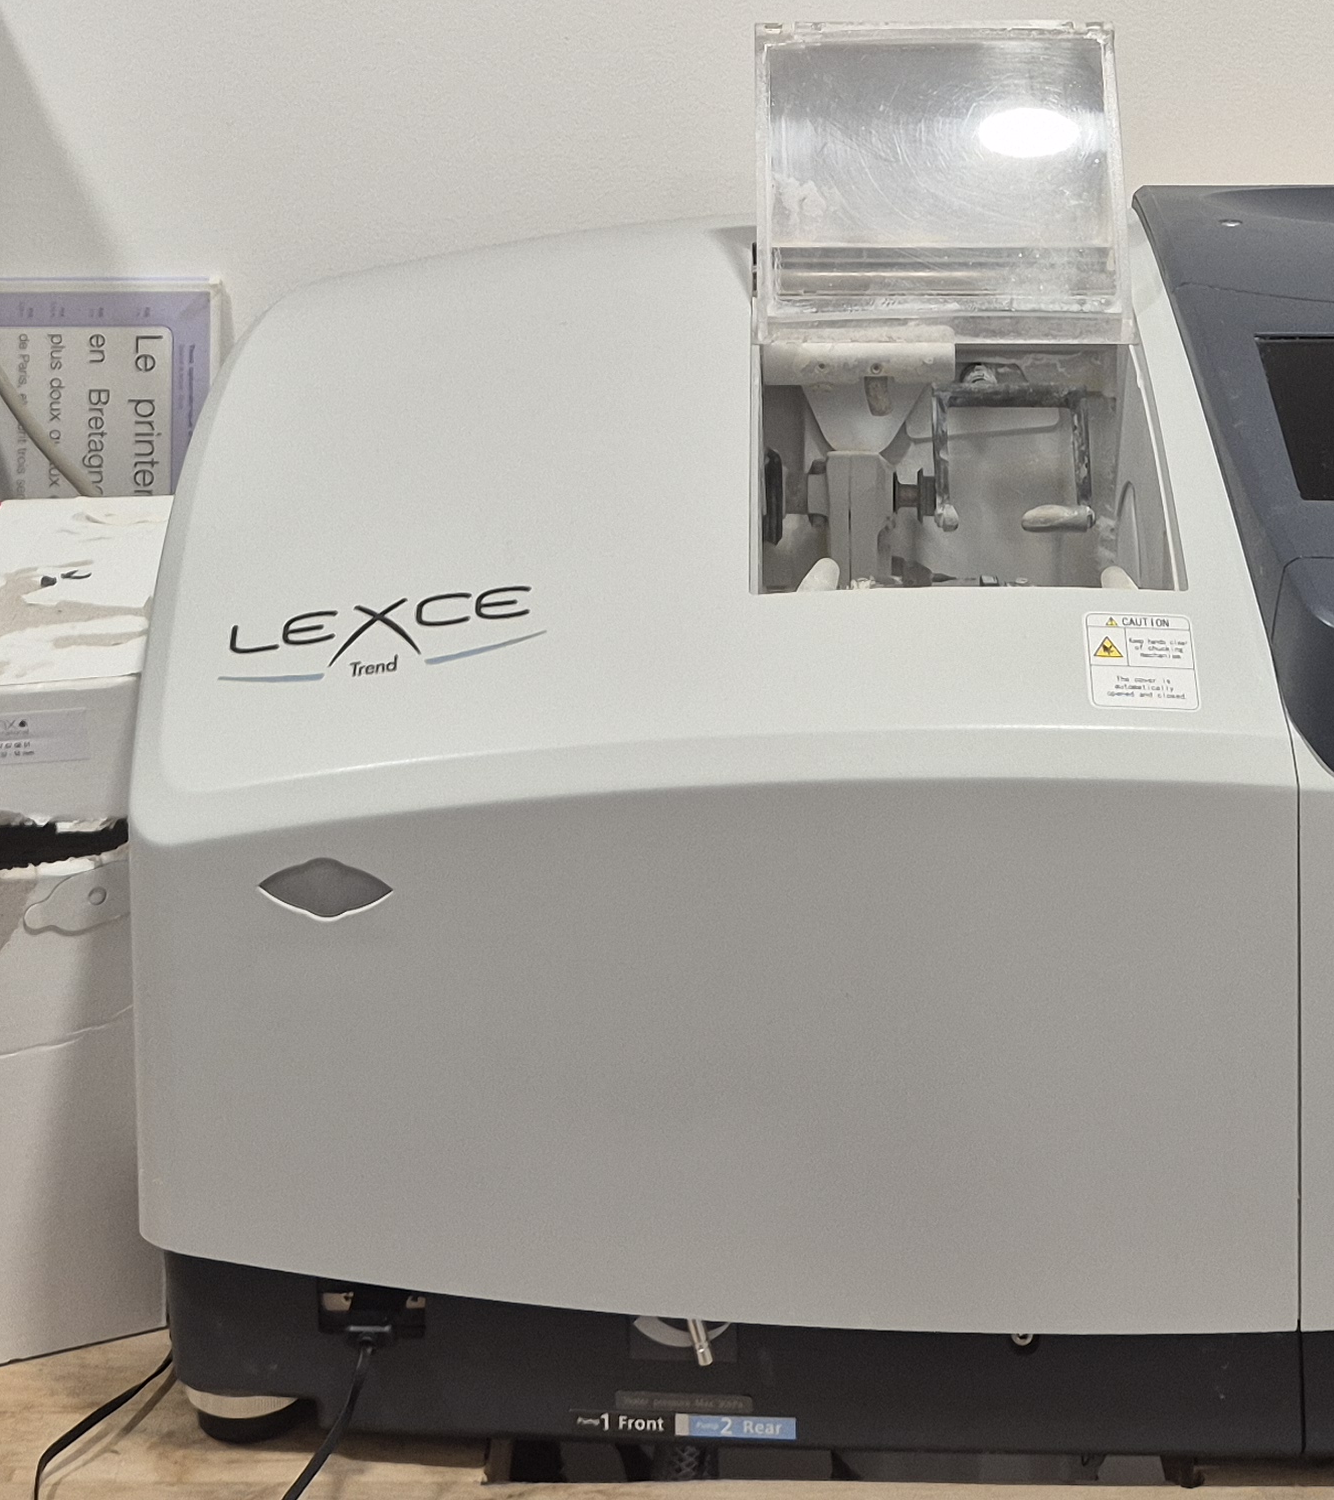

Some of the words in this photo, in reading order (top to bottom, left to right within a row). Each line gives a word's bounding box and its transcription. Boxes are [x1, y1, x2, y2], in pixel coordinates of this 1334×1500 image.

[46, 332, 64, 370] plus
[88, 333, 107, 364] en
[134, 334, 164, 373] Le
[48, 377, 66, 422] doux
[229, 584, 533, 667] LEXCE
[1121, 617, 1170, 628] CAUTION
[349, 654, 399, 677] Trend
[600, 1412, 611, 1431] 1
[618, 1414, 666, 1432] Front
[719, 1417, 733, 1435] 2
[742, 1419, 783, 1436] Rear
